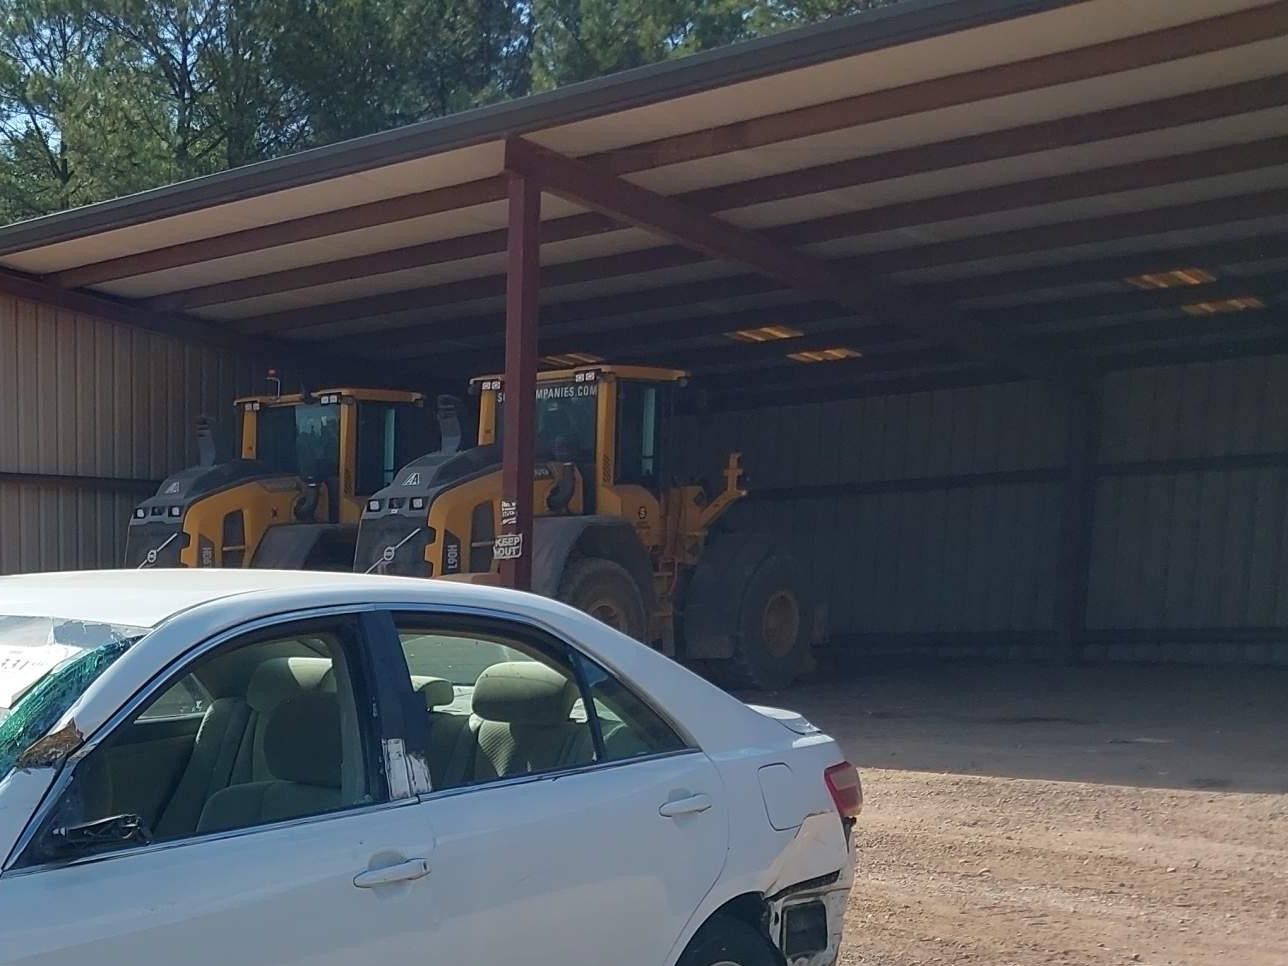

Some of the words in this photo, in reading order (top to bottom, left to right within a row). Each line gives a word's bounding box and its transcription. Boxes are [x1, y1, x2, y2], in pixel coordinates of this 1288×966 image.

[496, 537, 519, 547] KEEP
[497, 546, 520, 556] OUT
[447, 544, 458, 569] L90H
